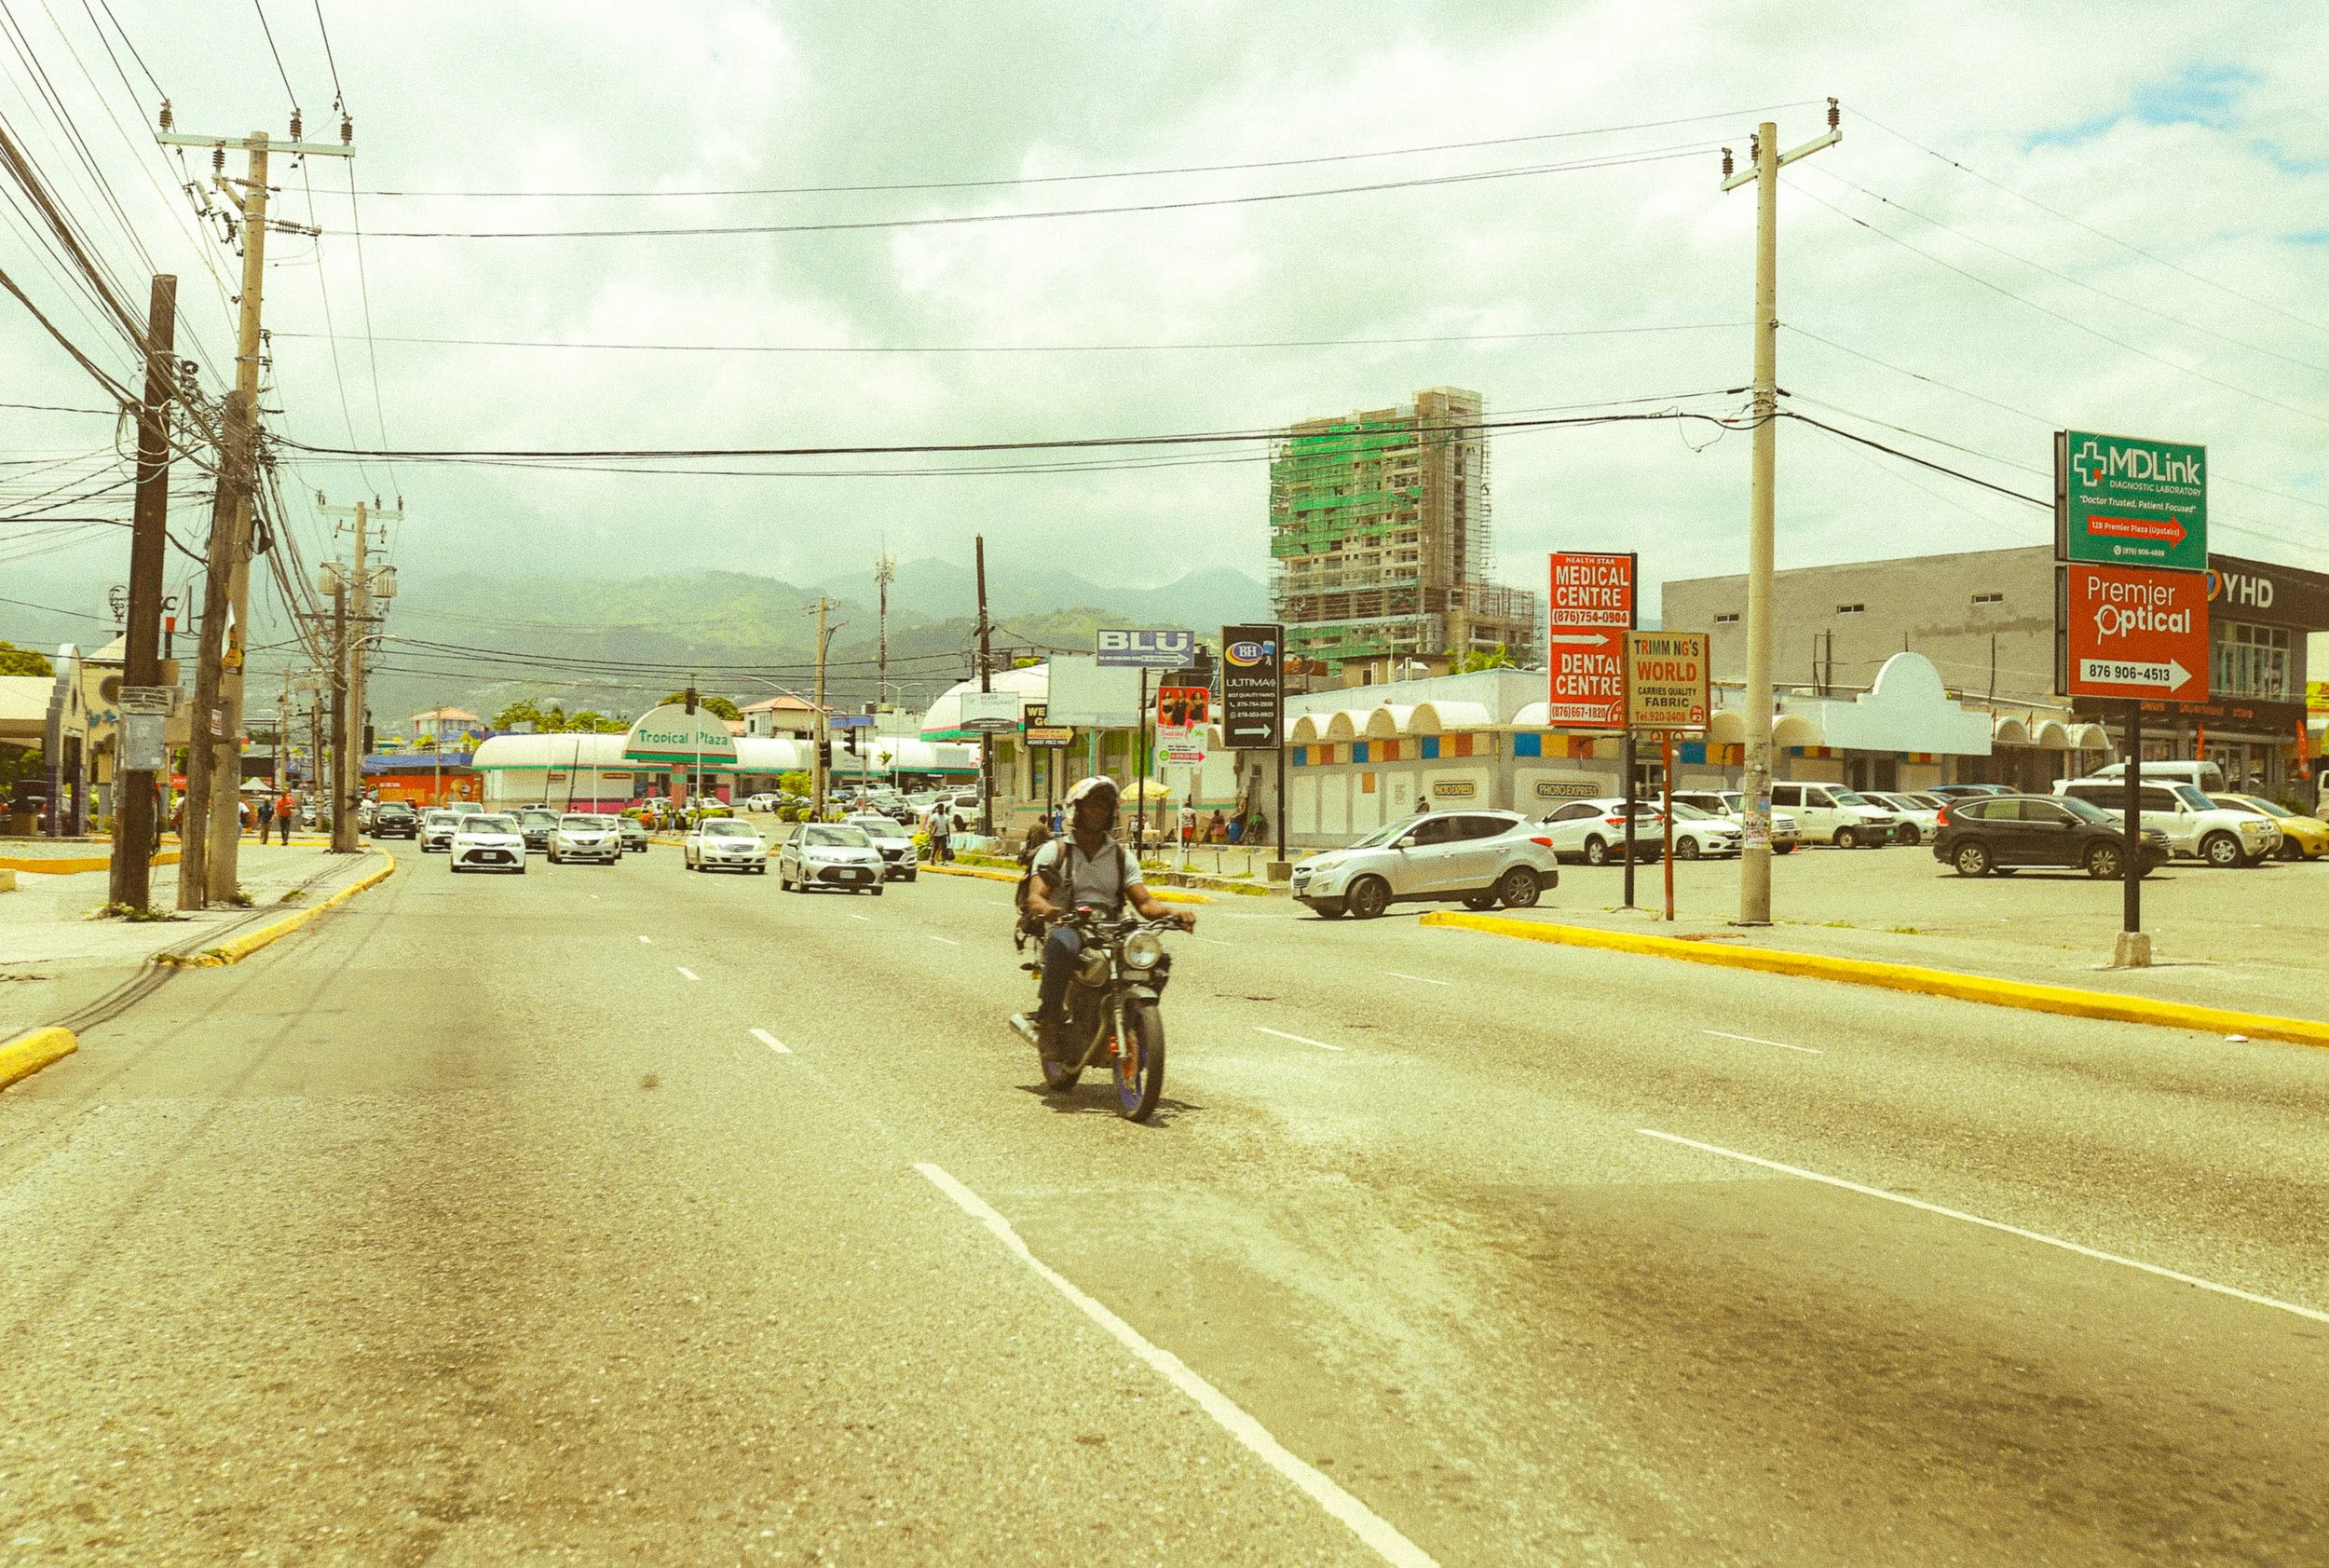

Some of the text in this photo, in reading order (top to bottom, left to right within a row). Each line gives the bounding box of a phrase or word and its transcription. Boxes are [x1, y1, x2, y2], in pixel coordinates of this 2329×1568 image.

[2109, 446, 2201, 485] MDLink
[2109, 480, 2201, 497] DIAGNOSTIC LABORATORY
[2138, 500, 2164, 511] Patient
[2104, 522, 2131, 532] Premier
[2131, 524, 2148, 533] Plaza
[1565, 556, 1595, 565] HEALTH
[1556, 565, 1629, 587] MEDICAL
[1557, 585, 1622, 607] CENTRE
[2088, 575, 2176, 607] Premier
[2223, 572, 2274, 608] YHD
[2093, 604, 2191, 646] Optical
[1239, 645, 1258, 658] BH
[1637, 661, 1697, 682] WORLD
[2090, 663, 2171, 681] 876 906-4513
[1556, 674, 1622, 697] CENTRE
[1638, 687, 1697, 697] CARRIES QUALITY
[1645, 697, 1690, 708] FABRIC
[1027, 707, 1046, 716] WE
[639, 729, 729, 746] Tropical Plaza
[1538, 784, 1598, 797] PHOTO EXPRESS
